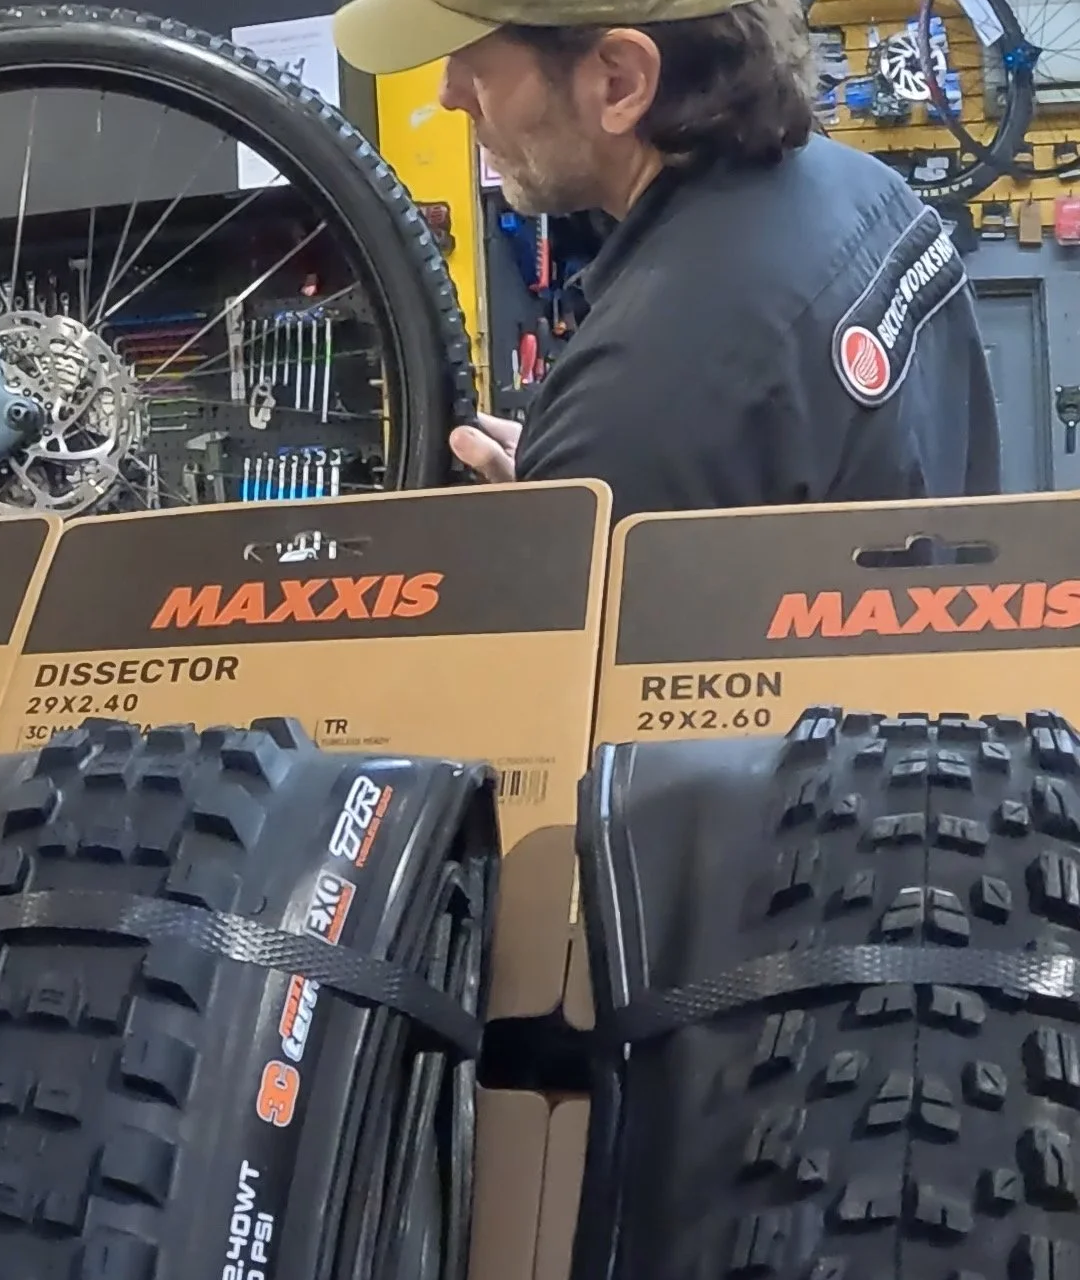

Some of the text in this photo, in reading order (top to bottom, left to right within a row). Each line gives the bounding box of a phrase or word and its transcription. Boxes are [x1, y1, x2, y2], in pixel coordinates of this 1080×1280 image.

[150, 572, 445, 630] MAXXIS
[766, 579, 1080, 639] MAXXIS
[33, 655, 240, 688] DISSECTOR
[640, 671, 782, 702] REKON
[25, 693, 139, 715] 29X2.40
[636, 708, 772, 731] 29X2.60
[324, 719, 348, 735] TR
[328, 775, 381, 860] TR
[251, 1212, 274, 1263] PSI
